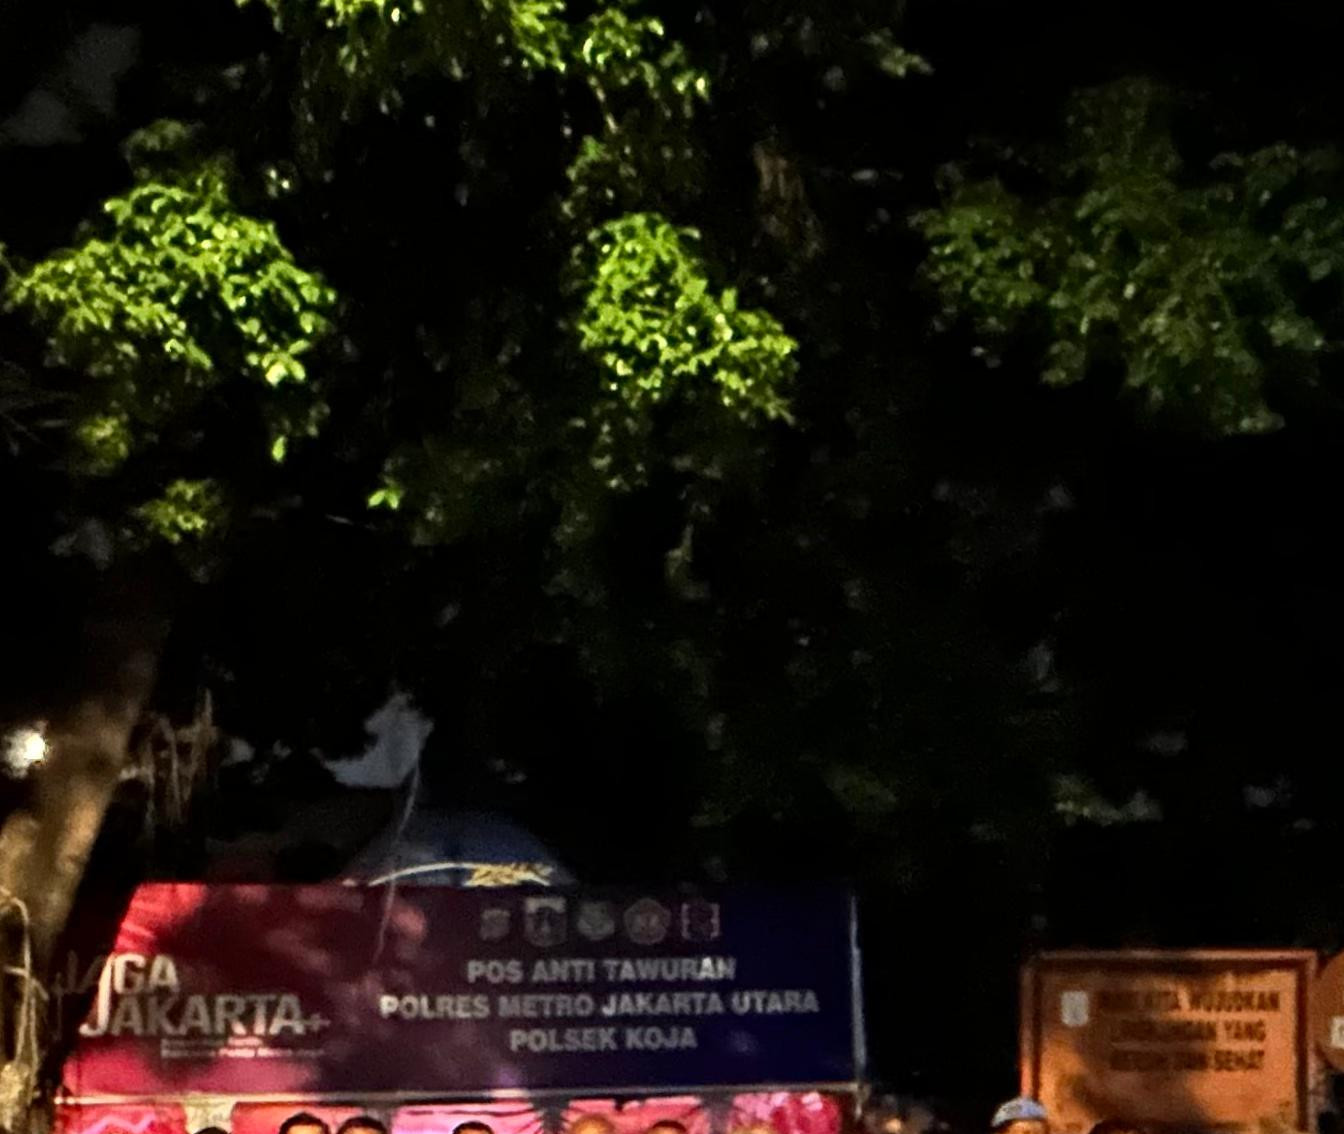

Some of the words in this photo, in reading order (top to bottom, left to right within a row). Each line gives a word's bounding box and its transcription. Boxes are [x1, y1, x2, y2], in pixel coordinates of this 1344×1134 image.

[467, 961, 523, 983] POS
[532, 959, 594, 981] ANTI
[604, 955, 736, 982] TAWURAN
[379, 995, 490, 1019] POLRES
[498, 994, 593, 1018] METRO
[601, 991, 724, 1017] JAKARTA
[731, 988, 820, 1014] UTARA
[510, 1028, 617, 1053] POLSEK
[625, 1026, 698, 1051] KOJA
[1225, 1019, 1268, 1042] YANG
